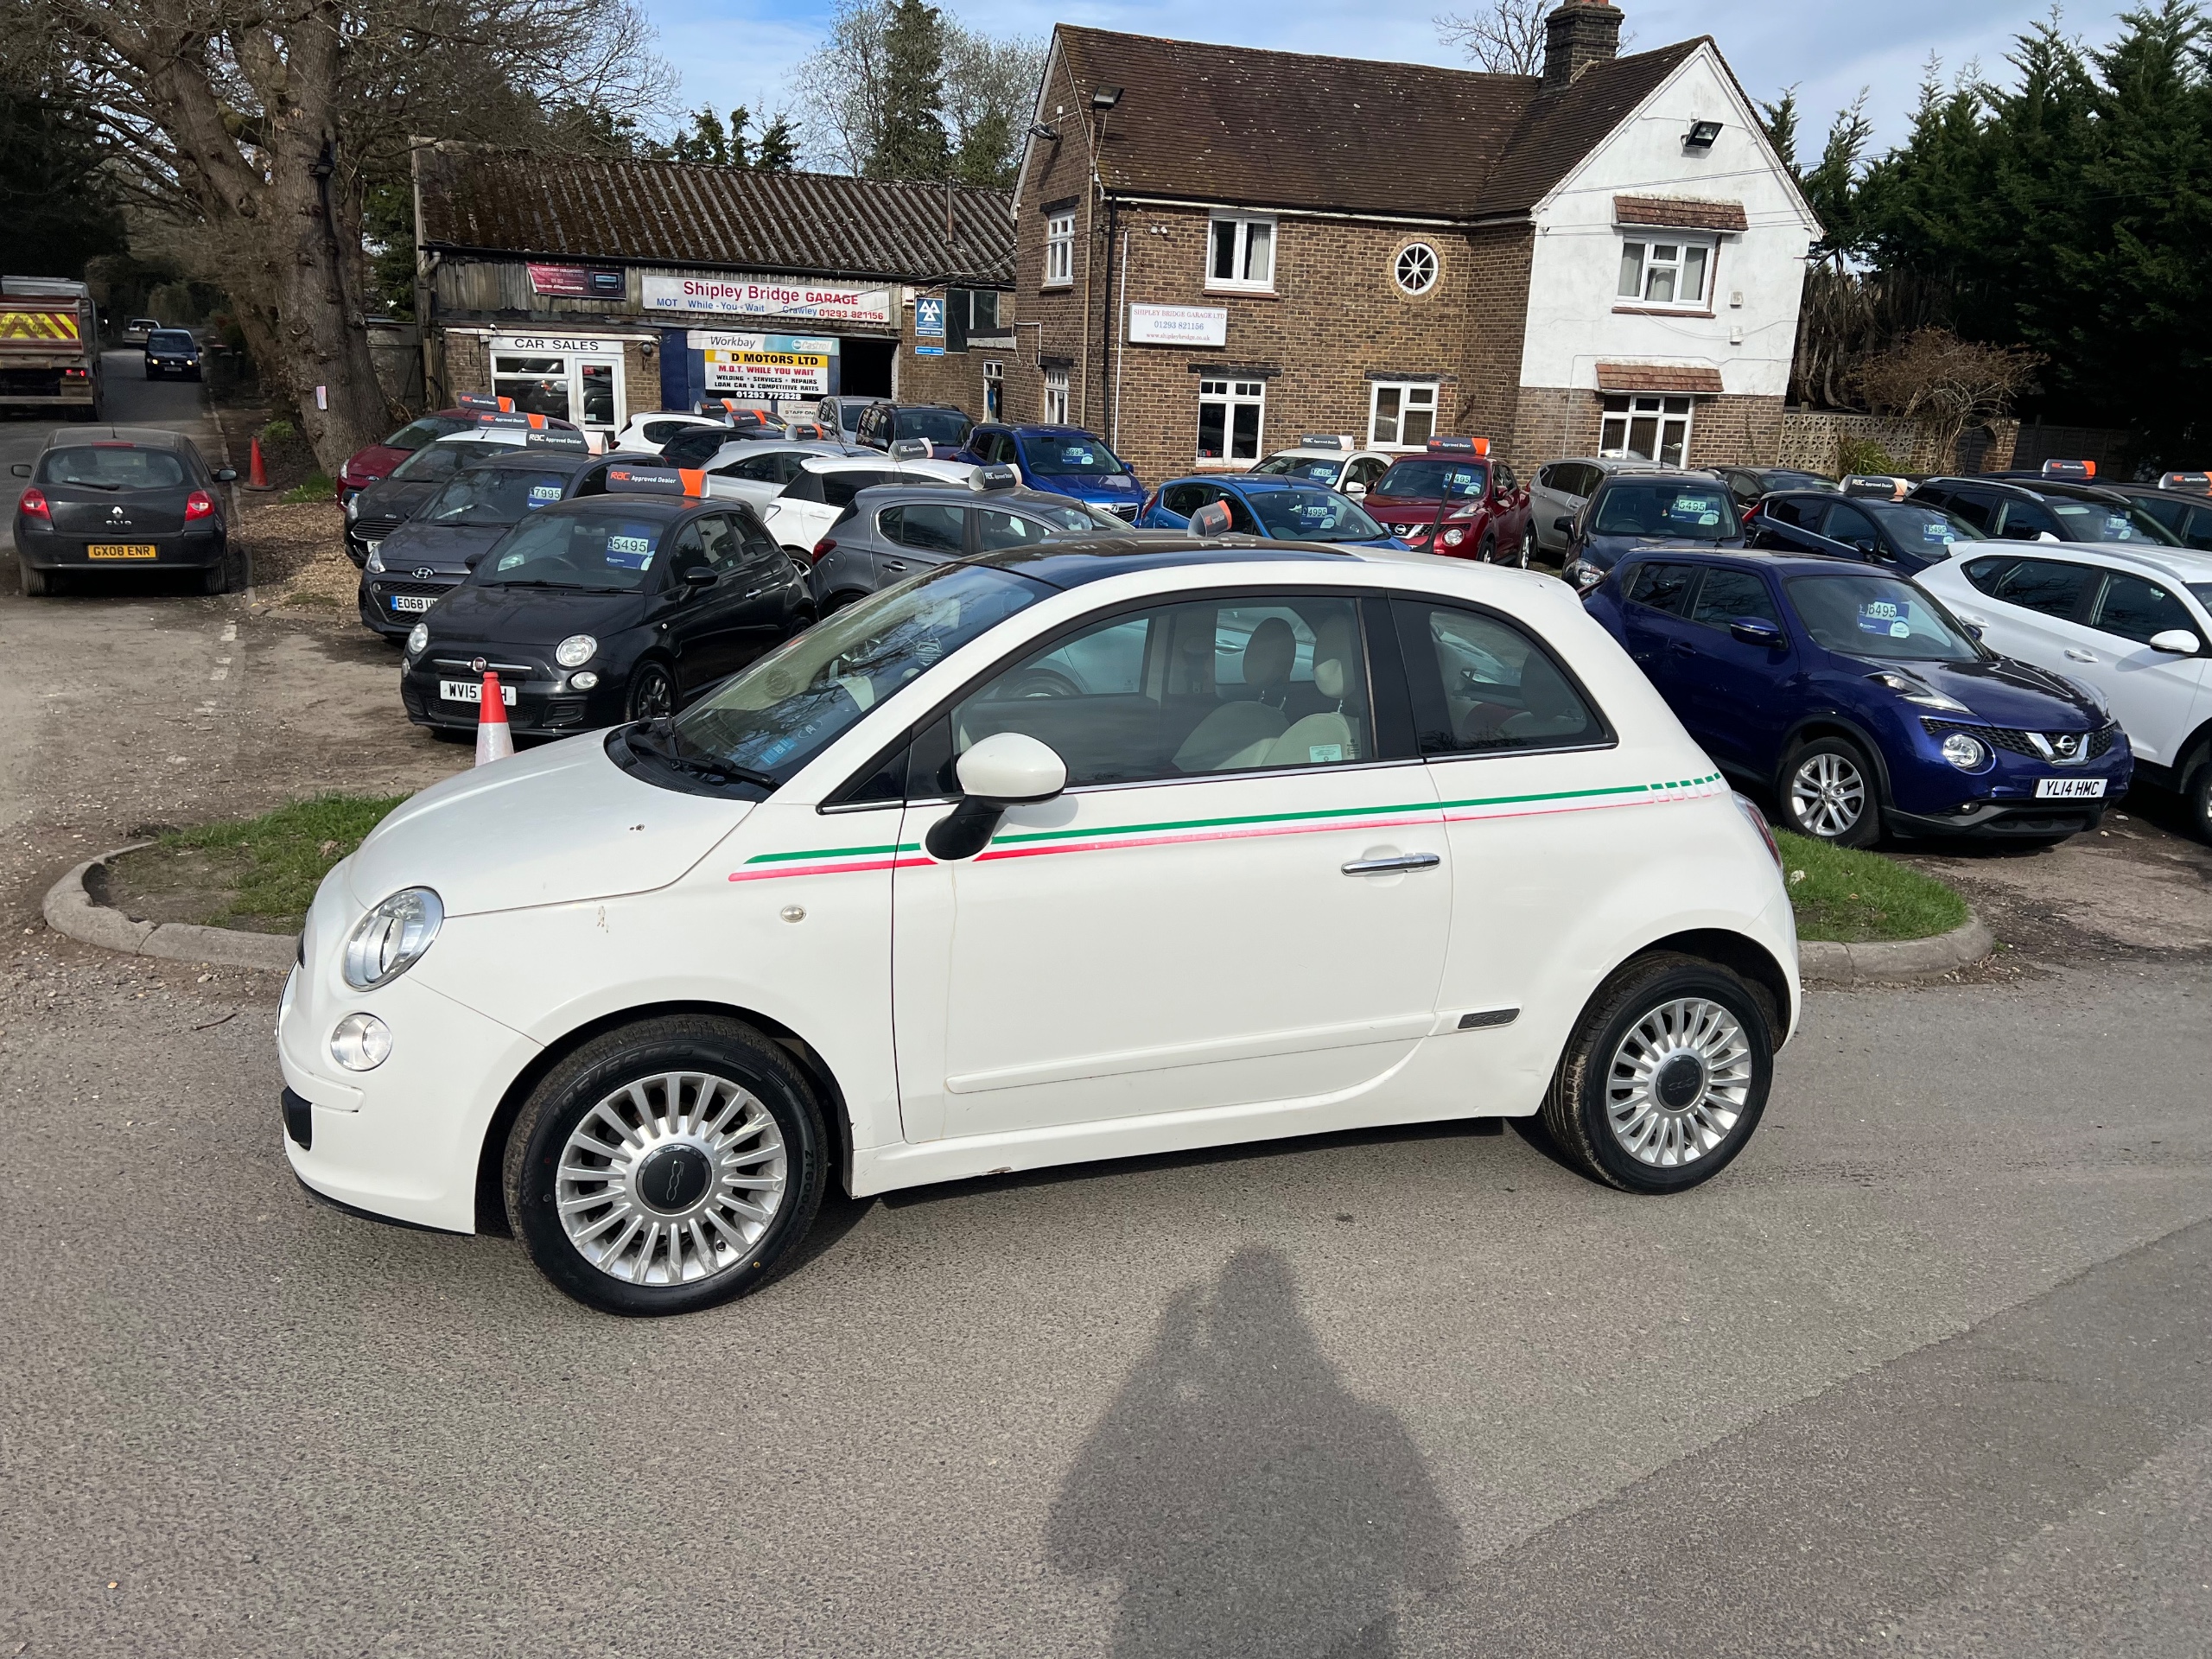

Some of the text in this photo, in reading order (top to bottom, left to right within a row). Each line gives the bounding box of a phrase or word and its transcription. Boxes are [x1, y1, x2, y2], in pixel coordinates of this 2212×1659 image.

[683, 281, 858, 305] Shipley Bridge GARAGE
[657, 298, 677, 307] MOT
[688, 300, 713, 309] While
[721, 302, 737, 310] You
[745, 303, 765, 312] Wait
[782, 305, 817, 316] Crawley
[819, 308, 847, 317] 01293
[851, 311, 883, 320] 821156
[1178, 321, 1204, 330] 821156
[515, 338, 599, 351] CAR SALES
[710, 336, 830, 351] Workbay Castrol
[731, 353, 818, 365] D MOTORS LTD
[747, 365, 772, 374] WHILE
[767, 391, 802, 400] 772828
[93, 546, 150, 556] GX08 ENR
[449, 683, 477, 698] WV15
[2046, 781, 2100, 796] YL14 HMC
